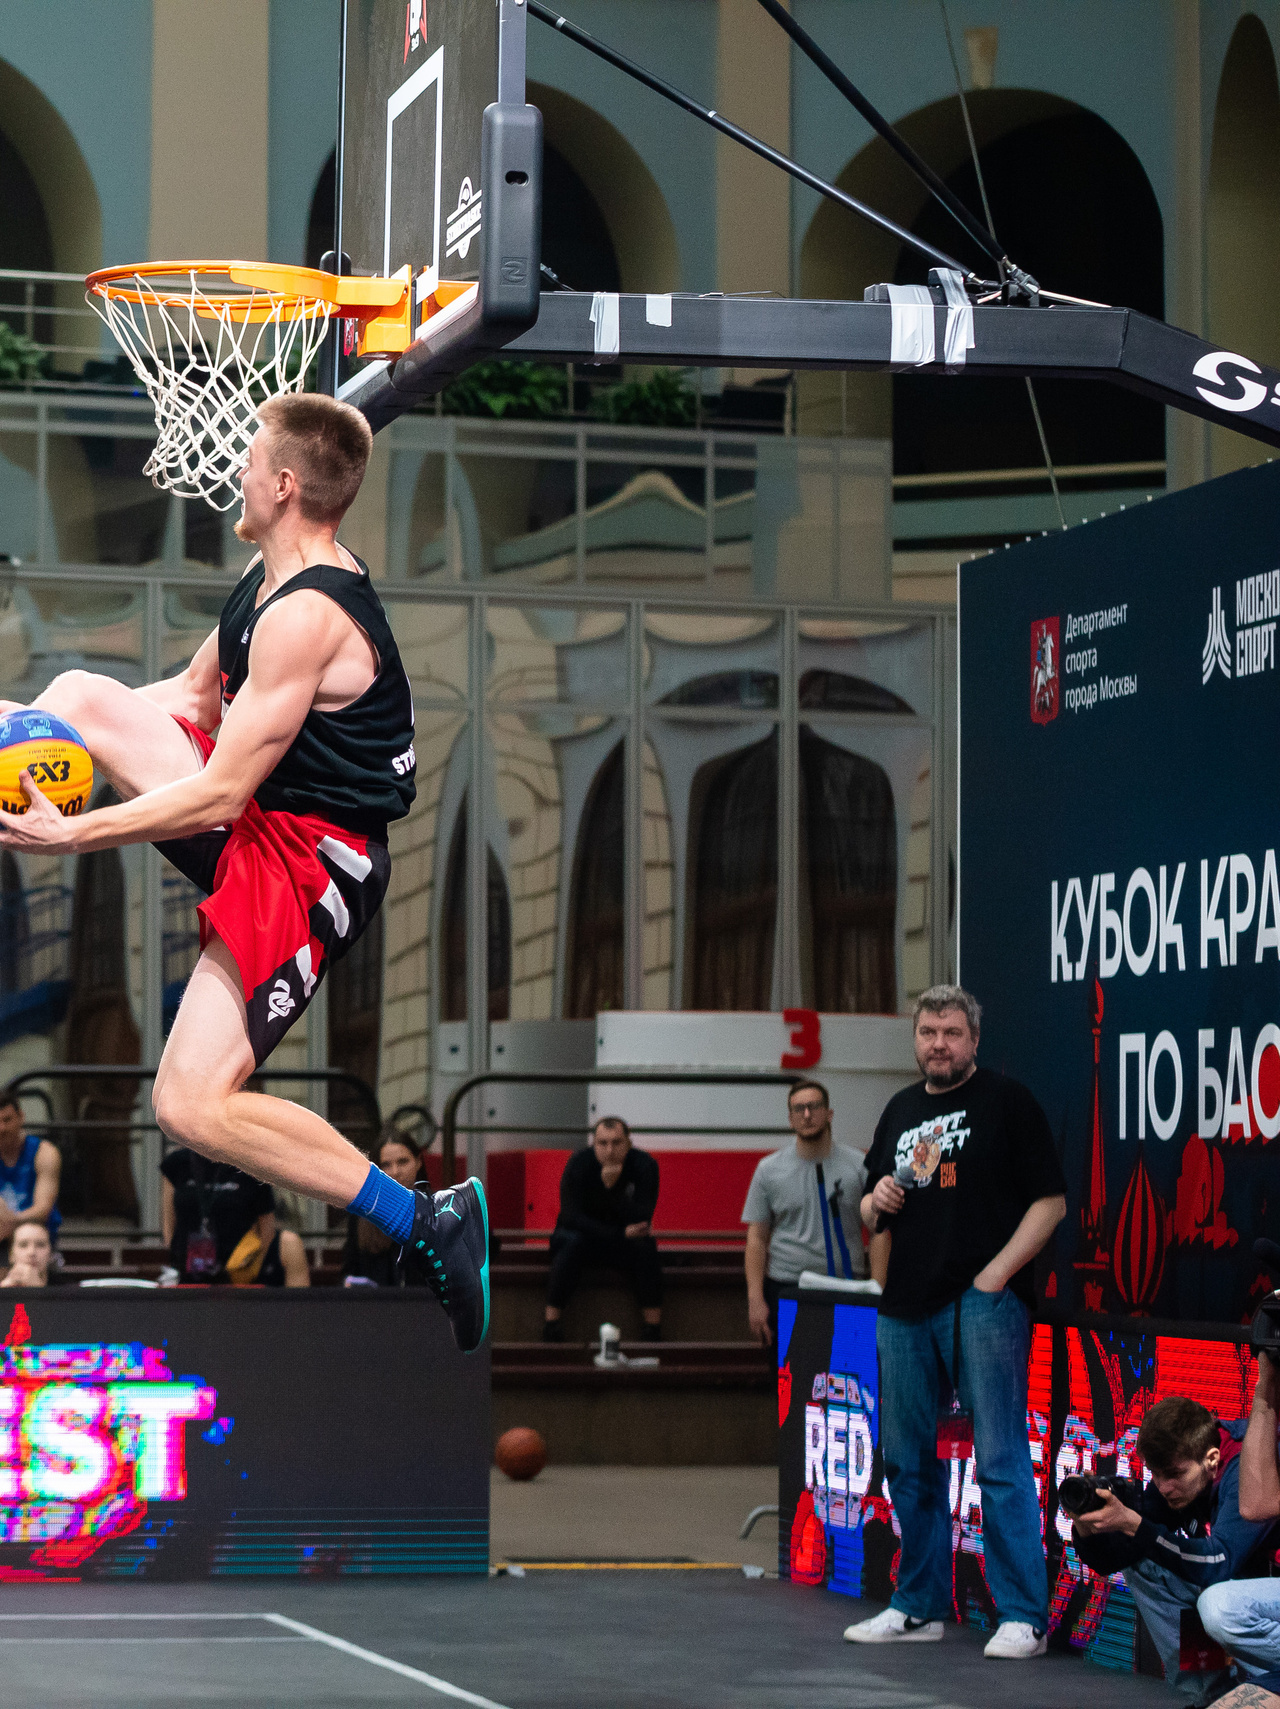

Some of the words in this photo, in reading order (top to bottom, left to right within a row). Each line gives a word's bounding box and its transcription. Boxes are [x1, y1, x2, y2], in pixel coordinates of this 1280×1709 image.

[1065, 603, 1128, 644] Департамент
[1236, 622, 1277, 678] СПОРТ
[1065, 648, 1098, 677] спорта
[1065, 683, 1098, 714] города
[1100, 674, 1138, 701] Москвы
[1051, 862, 1187, 983] КУБОК
[1200, 849, 1280, 969] КРА
[781, 1008, 822, 1069] 3
[1119, 1029, 1183, 1141] ПО
[804, 1402, 873, 1498] RED
